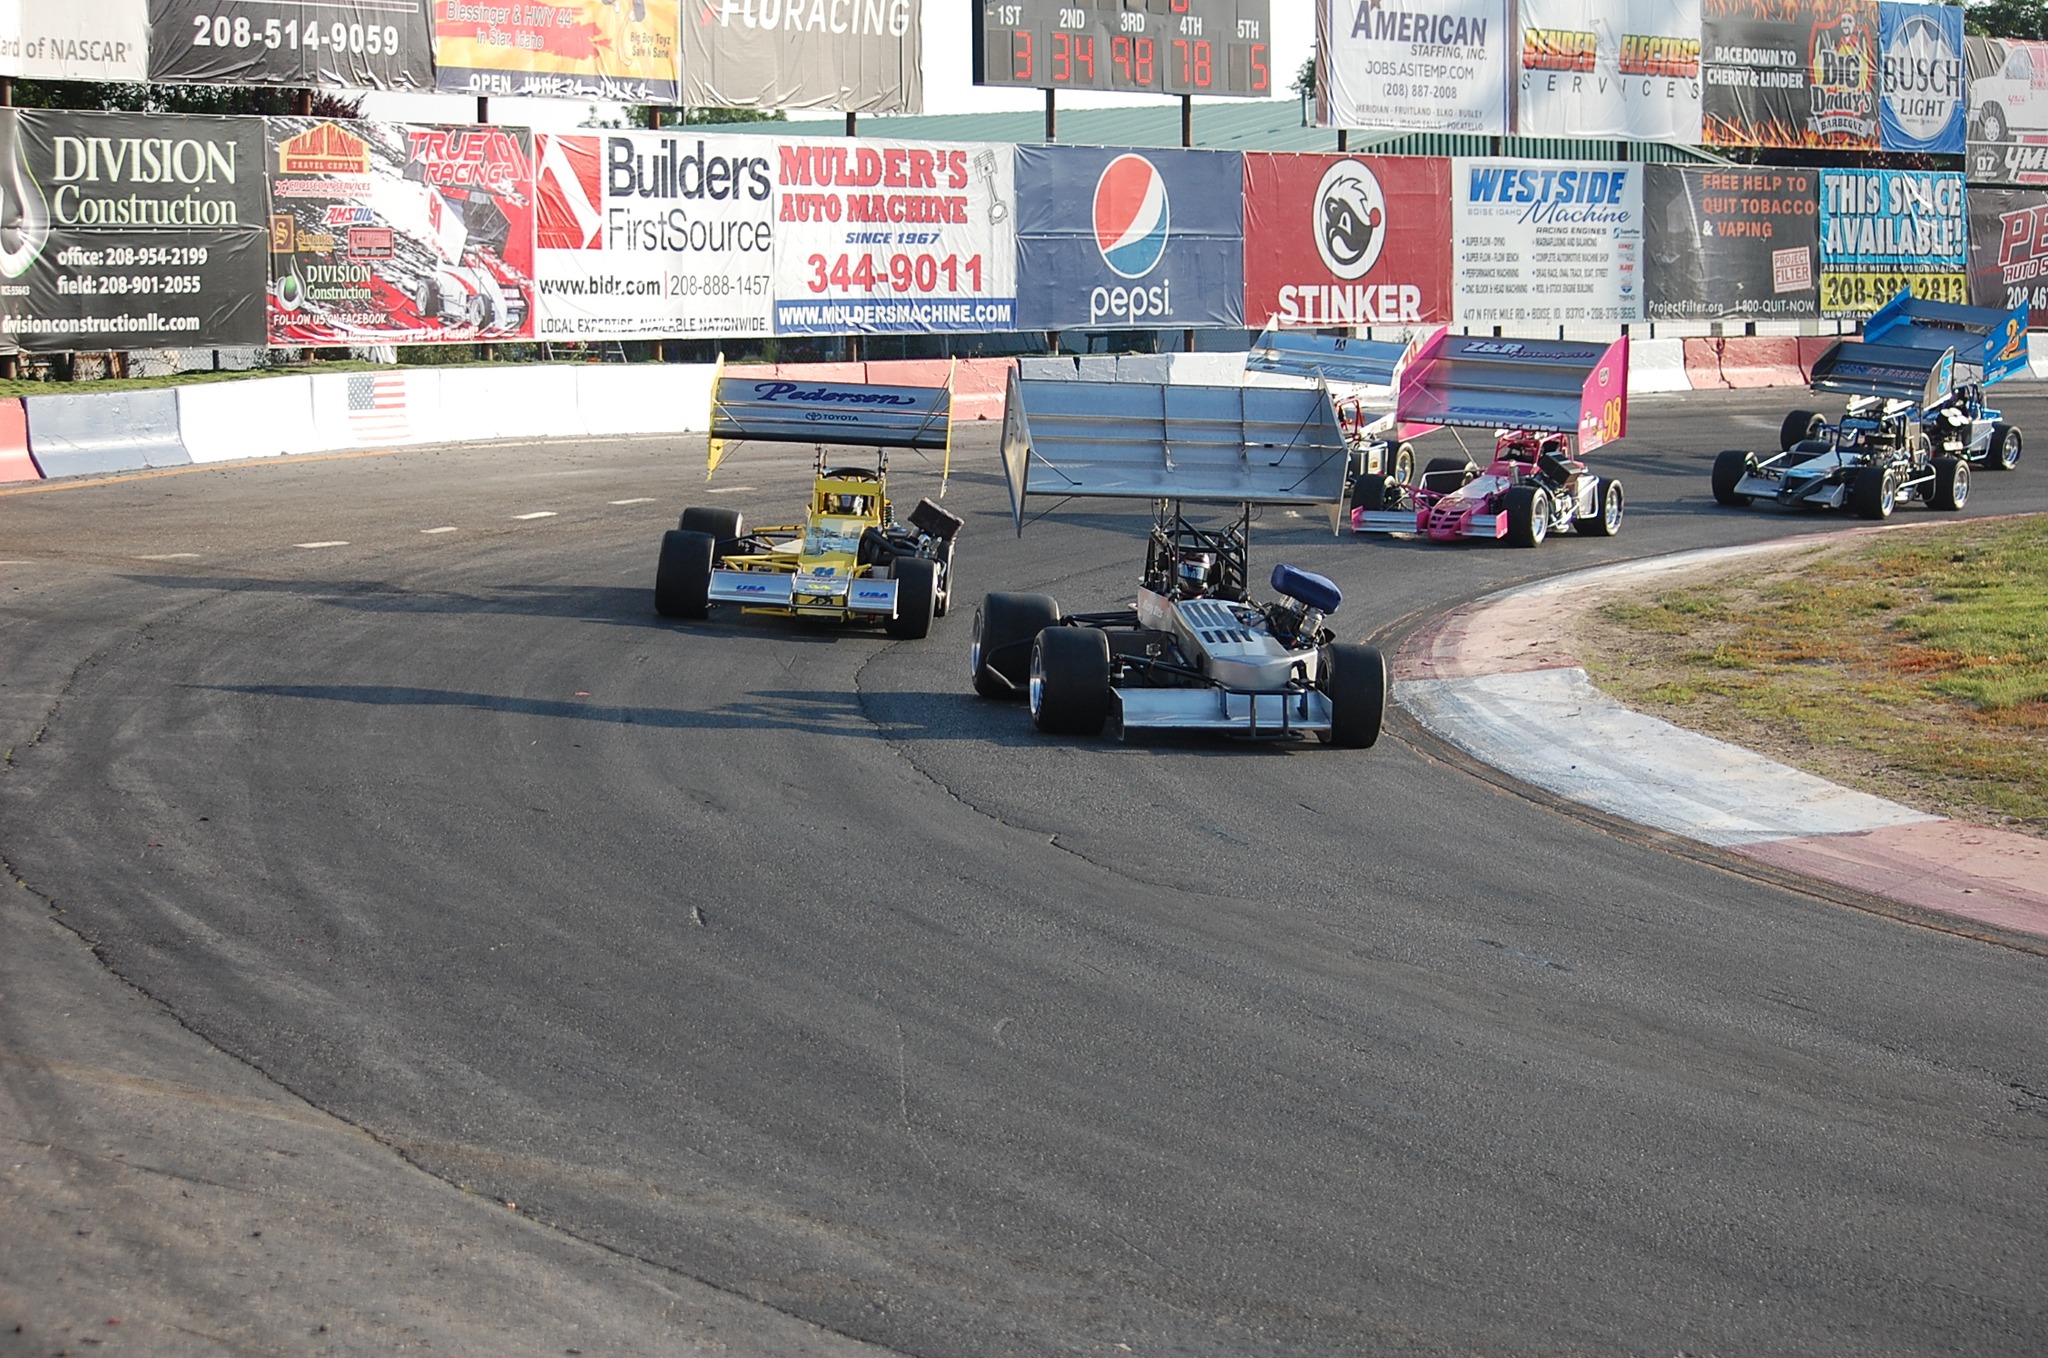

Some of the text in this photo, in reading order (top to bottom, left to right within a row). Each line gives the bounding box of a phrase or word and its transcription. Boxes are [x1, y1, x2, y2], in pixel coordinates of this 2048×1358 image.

[447, 3, 572, 28] Blessinger & HWY 44
[998, 6, 1021, 25] 1ST
[1060, 11, 1085, 28] 2ND
[1120, 13, 1145, 32] 3RD
[1179, 16, 1203, 35] 4TH
[1351, 0, 1487, 47] AMERICAN
[193, 15, 399, 55] 208-514-9059
[477, 28, 487, 44] in
[516, 31, 544, 49] Idaho
[1237, 20, 1259, 38] 5TH
[27, 38, 46, 59] of
[1015, 31, 1032, 78] 3
[1054, 34, 1094, 79] 34
[1466, 48, 1488, 61] INC.
[1715, 46, 1797, 66] RACE DOWN TO
[1112, 37, 1154, 84] 98
[1174, 40, 1212, 86] 78
[1251, 45, 1267, 89] 5
[469, 74, 511, 93] OPEN
[1707, 69, 1804, 88] CHERRY & LINDER
[1883, 56, 1960, 97] BUSCH
[1382, 83, 1457, 99] (208) 887-2008
[1811, 86, 1872, 114] Daddy's
[1900, 99, 1945, 117] LIGHT
[407, 130, 491, 164] TRUE
[52, 136, 238, 185] DIVISION
[608, 137, 772, 201] Builders
[779, 145, 969, 189] MULDER'S
[424, 160, 506, 186] RACING
[1702, 174, 1807, 192] FREE HELP TO
[1469, 167, 1627, 205] WESTSIDE
[1825, 175, 1961, 216] THIS SPACE
[54, 184, 238, 225] Construction
[779, 193, 969, 224] AUTO MACHINE
[1518, 199, 1632, 225] Machine
[1702, 197, 1815, 215] QUIT TOBACCO
[325, 207, 374, 225] AMSOIL
[609, 208, 772, 252] FirstSource
[846, 233, 940, 245] SINCE 1967
[1702, 220, 1773, 238] & VAPING
[1827, 217, 1963, 256] AVAILABLE!
[57, 247, 208, 266] office: 208-954-2199
[1774, 253, 1808, 266] PROJECT
[307, 265, 371, 283] DIVISION
[807, 254, 981, 293] 344-9011
[1775, 266, 1809, 282] FILTER
[57, 275, 201, 294] field: 208-901-2055
[307, 285, 371, 300] Construction
[539, 275, 770, 296] www.bidr.com 208-888-1457
[1091, 278, 1172, 324] pepsi
[1278, 284, 1421, 324] STINKER
[1649, 300, 1815, 315] ProjectFilter.org 1-800-QUIT-NOW
[273, 314, 311, 326] FOLLOW
[313, 314, 326, 326] US
[340, 313, 387, 325] FACEBOOK
[541, 318, 574, 333] LOCAL
[779, 305, 1010, 326] WWW.MULDERSMACHINE.COM
[1938, 354, 1954, 396] 5
[755, 382, 915, 405] Pedersen
[823, 414, 859, 422] TOYOTA
[1424, 416, 1560, 433] HAMILTON
[1603, 396, 1622, 443] 98
